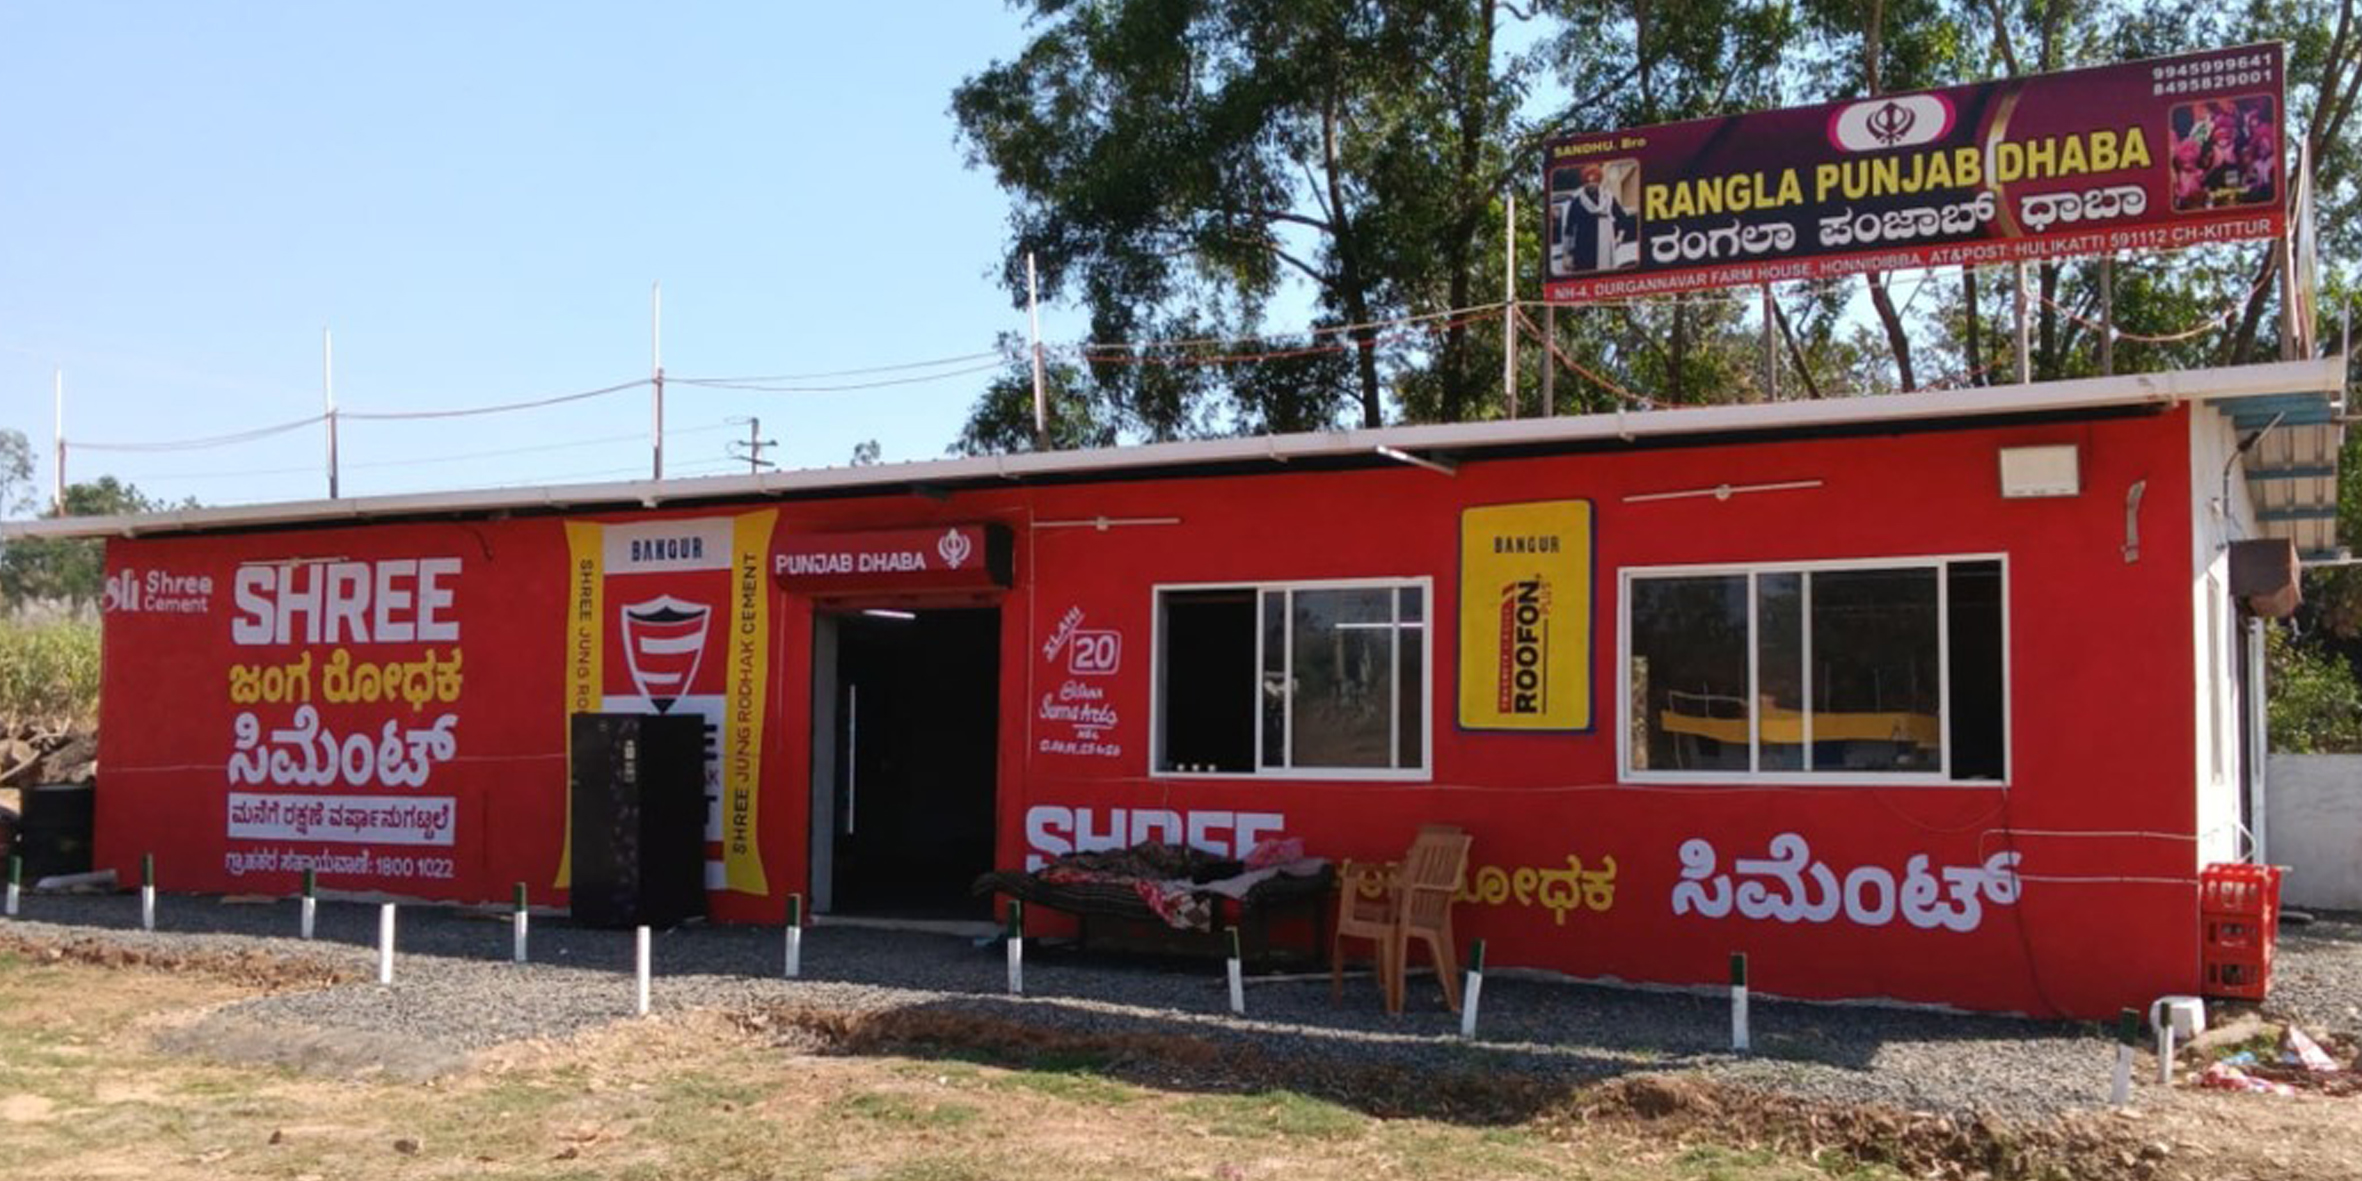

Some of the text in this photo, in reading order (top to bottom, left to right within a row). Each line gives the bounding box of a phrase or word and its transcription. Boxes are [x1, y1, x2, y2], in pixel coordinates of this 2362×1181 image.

[1645, 127, 2151, 221] RANGLA PUNJAB DHABA
[1651, 185, 2147, 263] ರಂಗಲಾ ಪಂಜಾಬ್ ಧಾಬಾ
[1711, 268, 1753, 285] FARM
[2015, 234, 2105, 257] HULIKATTI
[2110, 228, 2167, 248] 591112
[2172, 218, 2272, 242] CH-KITTUR
[776, 551, 926, 575] PUNJAB DHABA
[1494, 536, 1559, 553] BANGUR
[145, 595, 208, 613] Cement
[147, 570, 213, 594] Shree
[231, 557, 462, 645] SHREE
[579, 559, 593, 621] SHREE
[229, 647, 463, 712] ಜಂಗ ರೋಧಕ
[577, 627, 591, 679] JUNG
[1075, 634, 1115, 669] 20
[1515, 580, 1541, 714] ROOFON
[733, 553, 757, 855] SHREE JUNG RODHAK CEMENT
[228, 704, 459, 787] ಸಿಮೆಂಟ್
[376, 856, 414, 876] 1800
[417, 858, 454, 879] 1022
[1671, 833, 2022, 932] ಸಿಮೆಂಟ್
